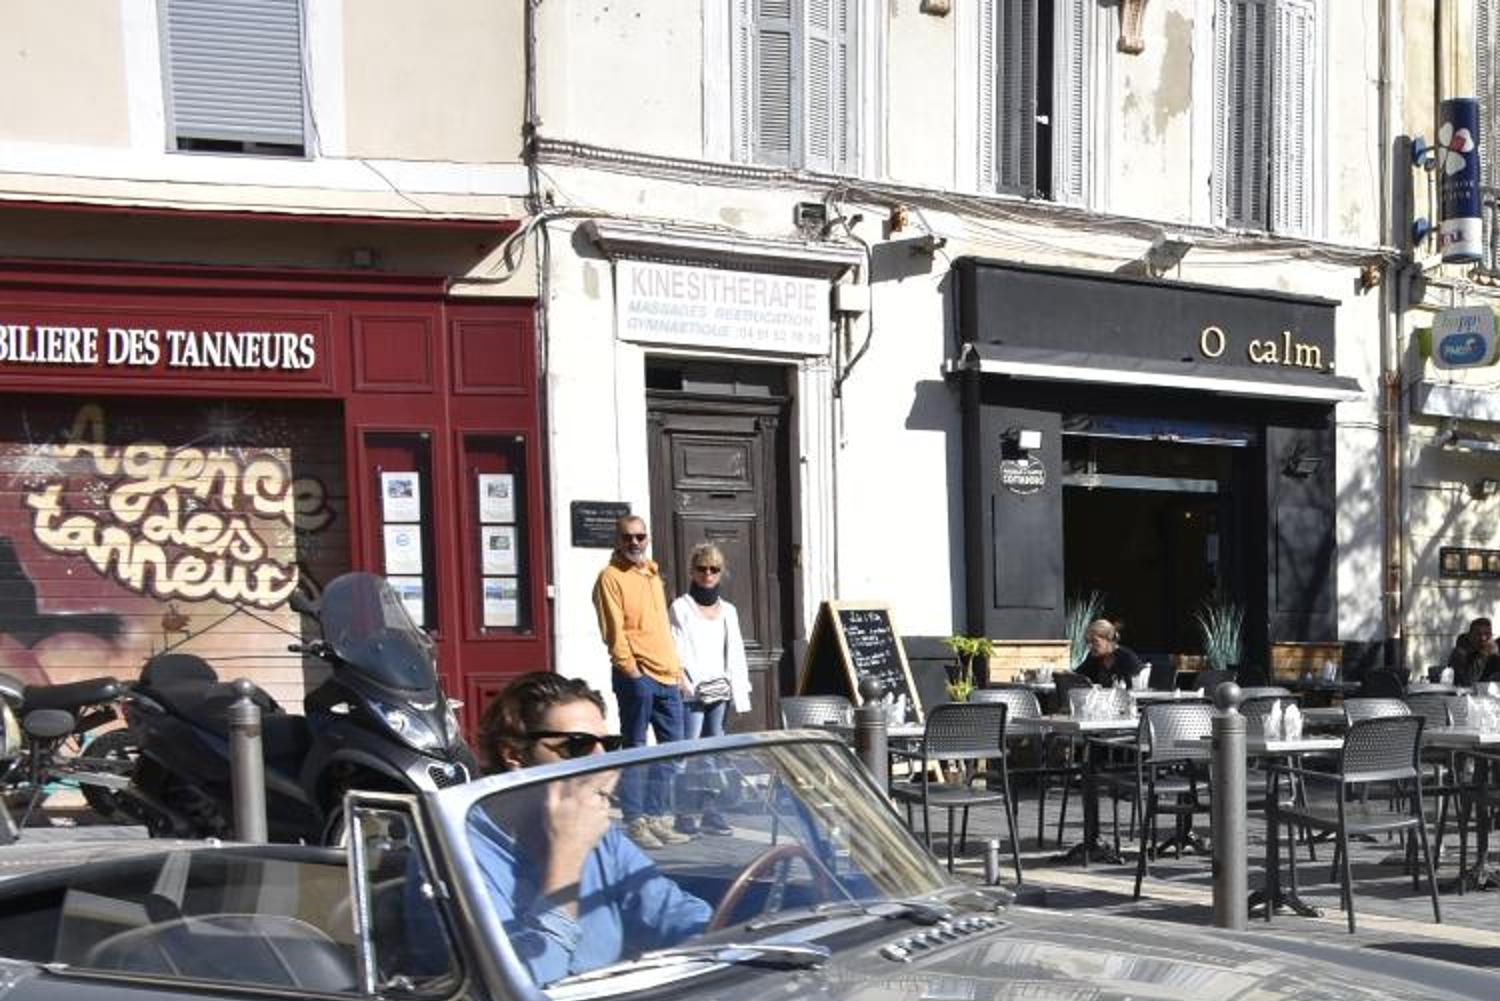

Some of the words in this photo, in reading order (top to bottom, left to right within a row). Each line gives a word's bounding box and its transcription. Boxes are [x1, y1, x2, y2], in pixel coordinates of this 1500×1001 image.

[631, 268, 816, 310] KINESITHERAPIE
[107, 328, 160, 365] DES
[166, 330, 316, 369] TANNEURS
[1201, 326, 1226, 358] O
[58, 403, 334, 531] Agence
[143, 488, 267, 564] des
